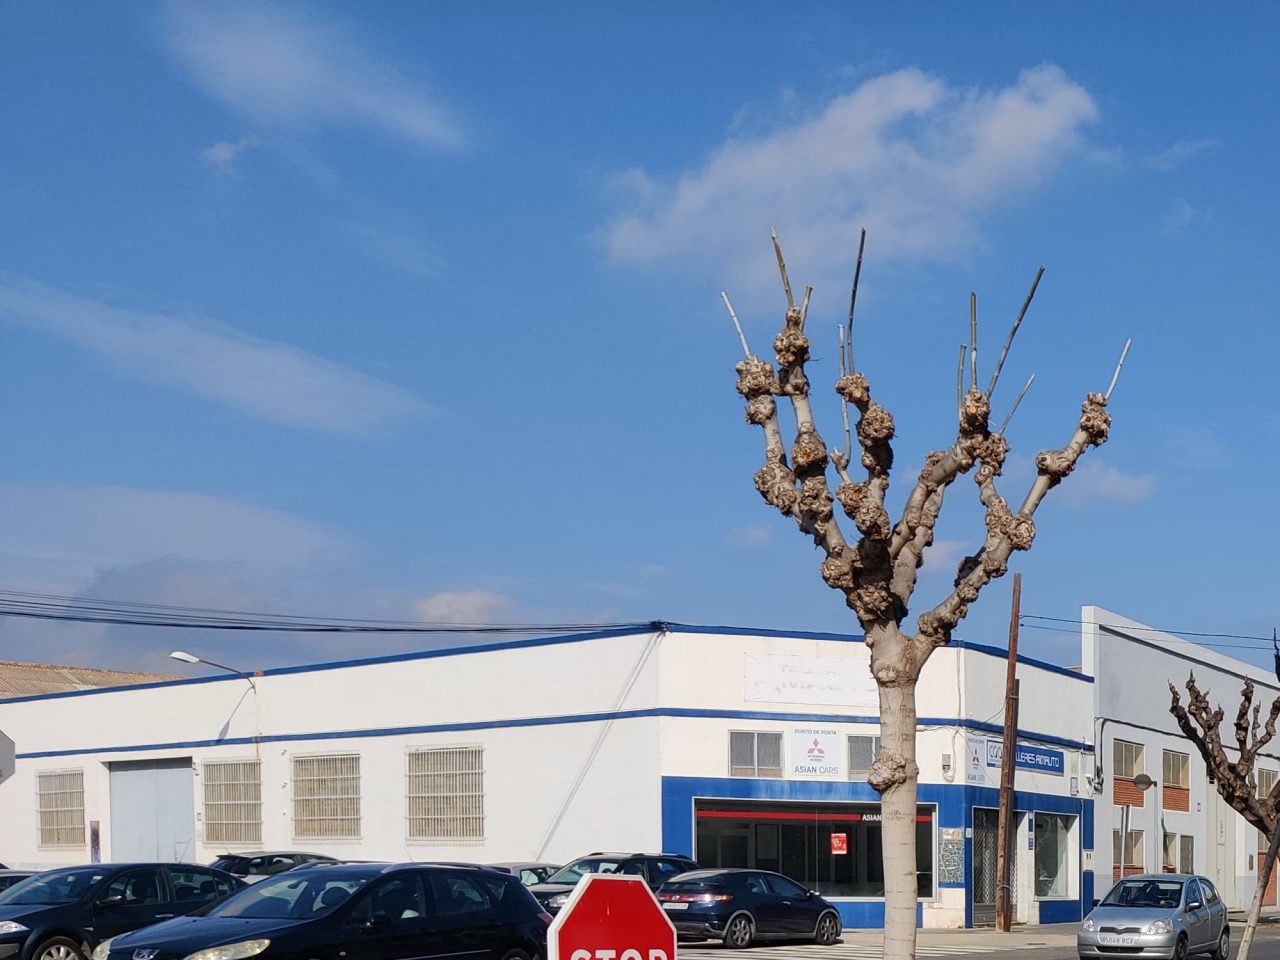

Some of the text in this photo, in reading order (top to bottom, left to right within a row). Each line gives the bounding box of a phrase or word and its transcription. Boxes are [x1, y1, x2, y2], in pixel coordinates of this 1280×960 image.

[794, 765, 839, 775] ASIAN CARS
[862, 813, 882, 822] ASIAN
